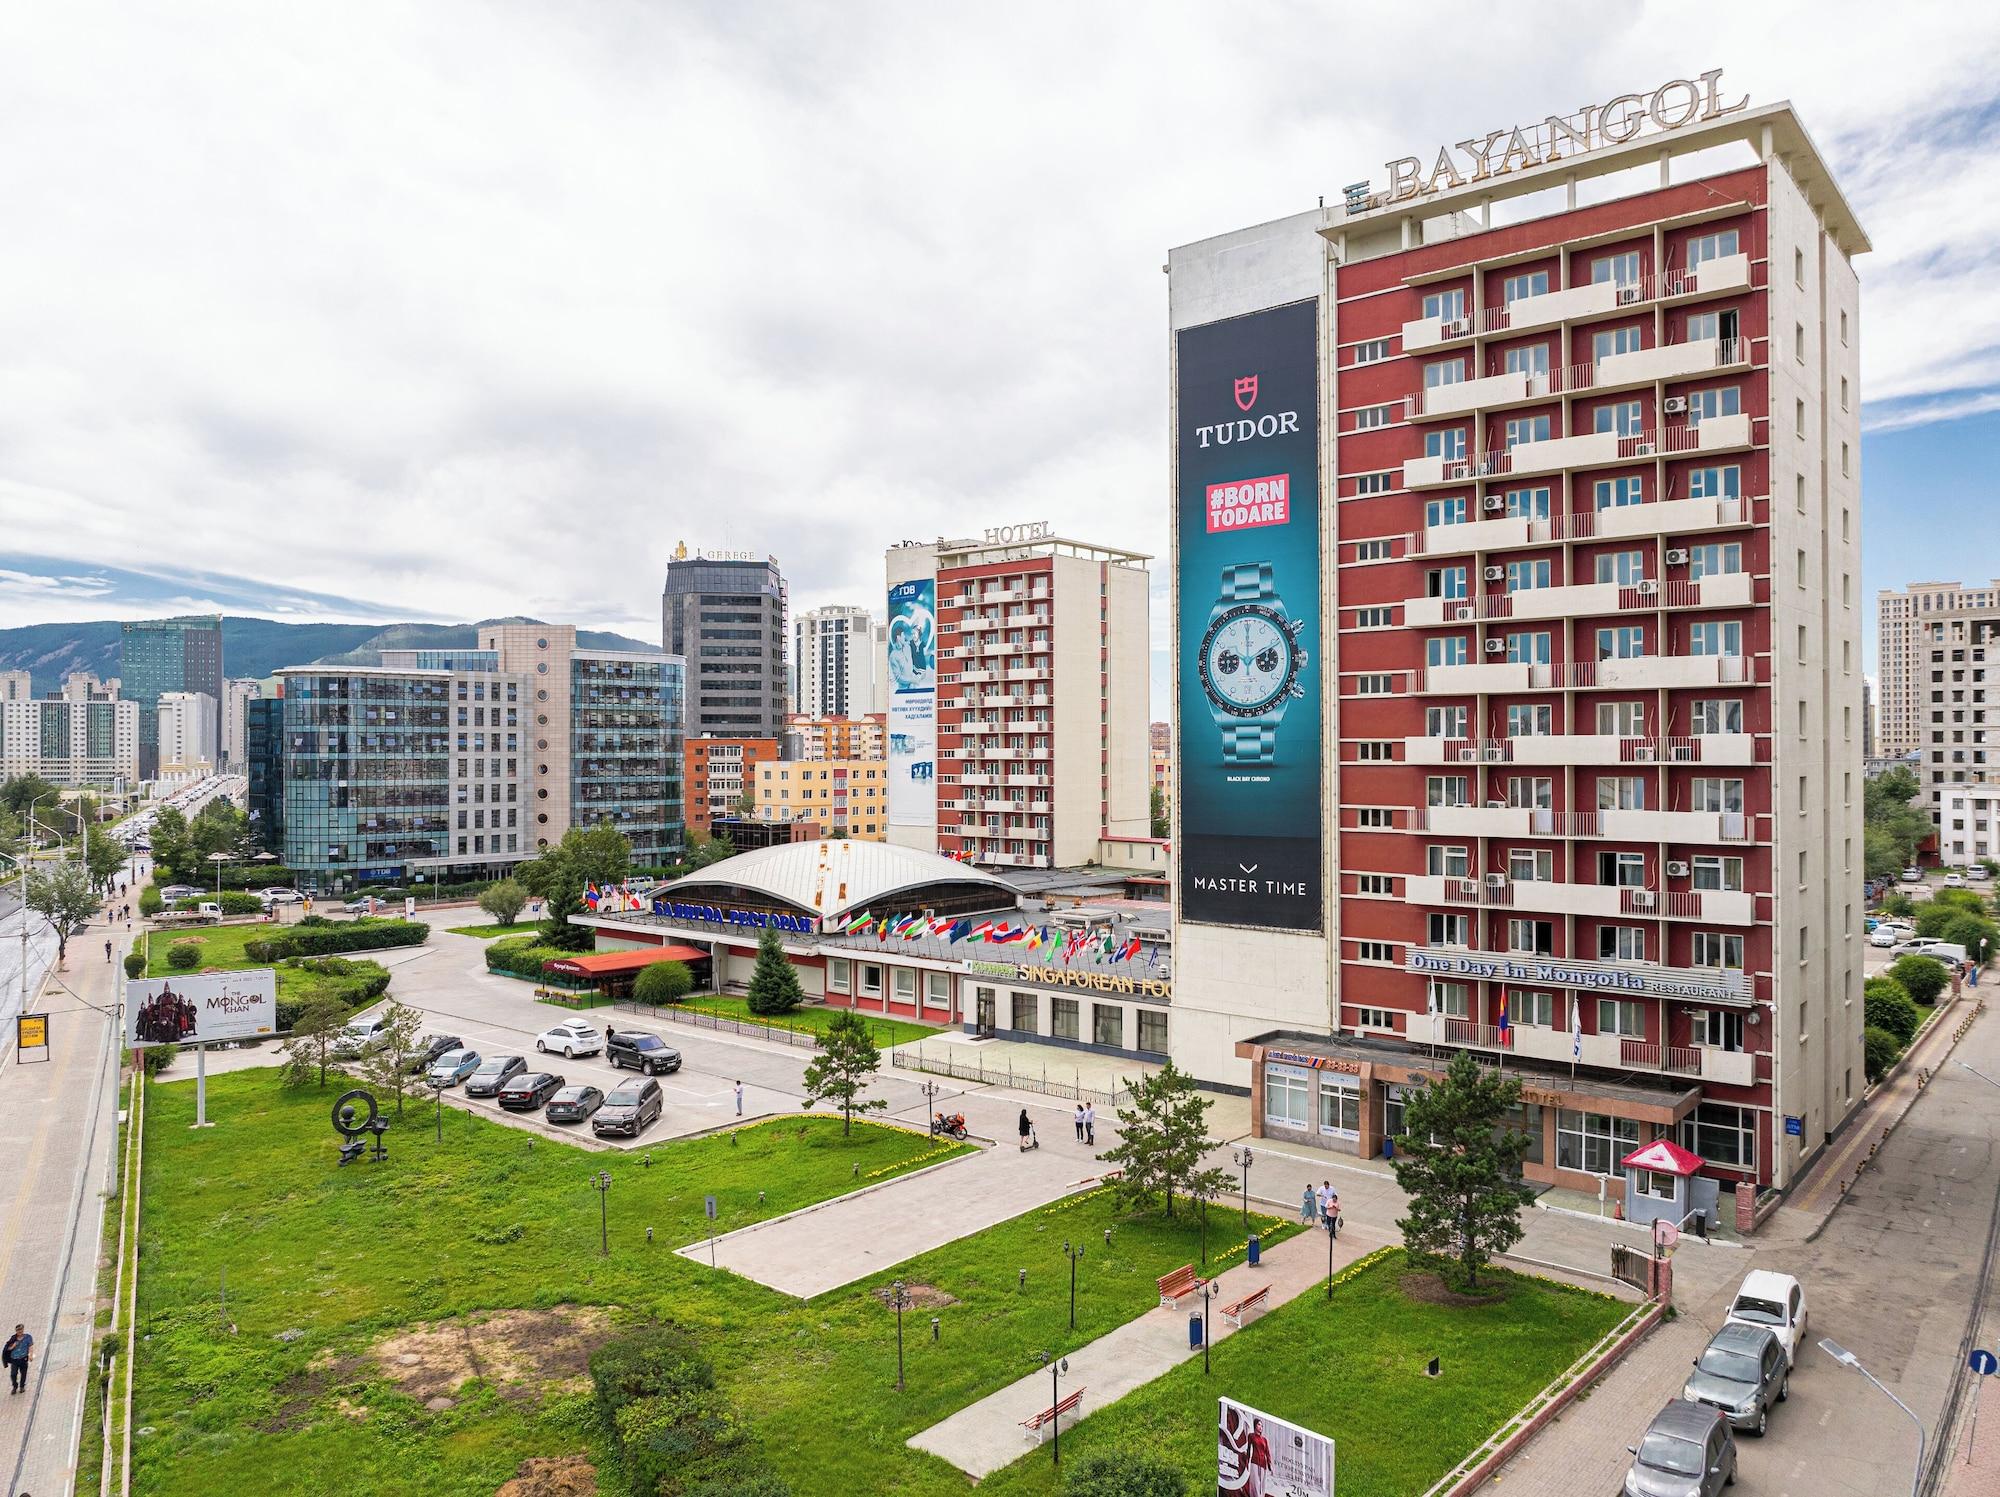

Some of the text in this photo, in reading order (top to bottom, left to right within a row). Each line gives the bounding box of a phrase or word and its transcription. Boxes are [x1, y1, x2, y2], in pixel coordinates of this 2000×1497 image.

[1385, 68, 1750, 203] BAYANGOL
[1196, 411, 1299, 449] TUDOR
[1211, 479, 1285, 510] #BORN
[1211, 502, 1285, 528] TODARE
[984, 520, 1055, 546] HOTEL
[707, 550, 756, 560] GEREGE
[1194, 876, 1306, 896] MASTER TIME
[1019, 964, 1135, 994] SINGAPOREAN
[1410, 954, 1736, 1000] One Day in Mongolia RESTAURANT
[206, 994, 267, 1009] MONGOL
[225, 1005, 250, 1014] KHAN
